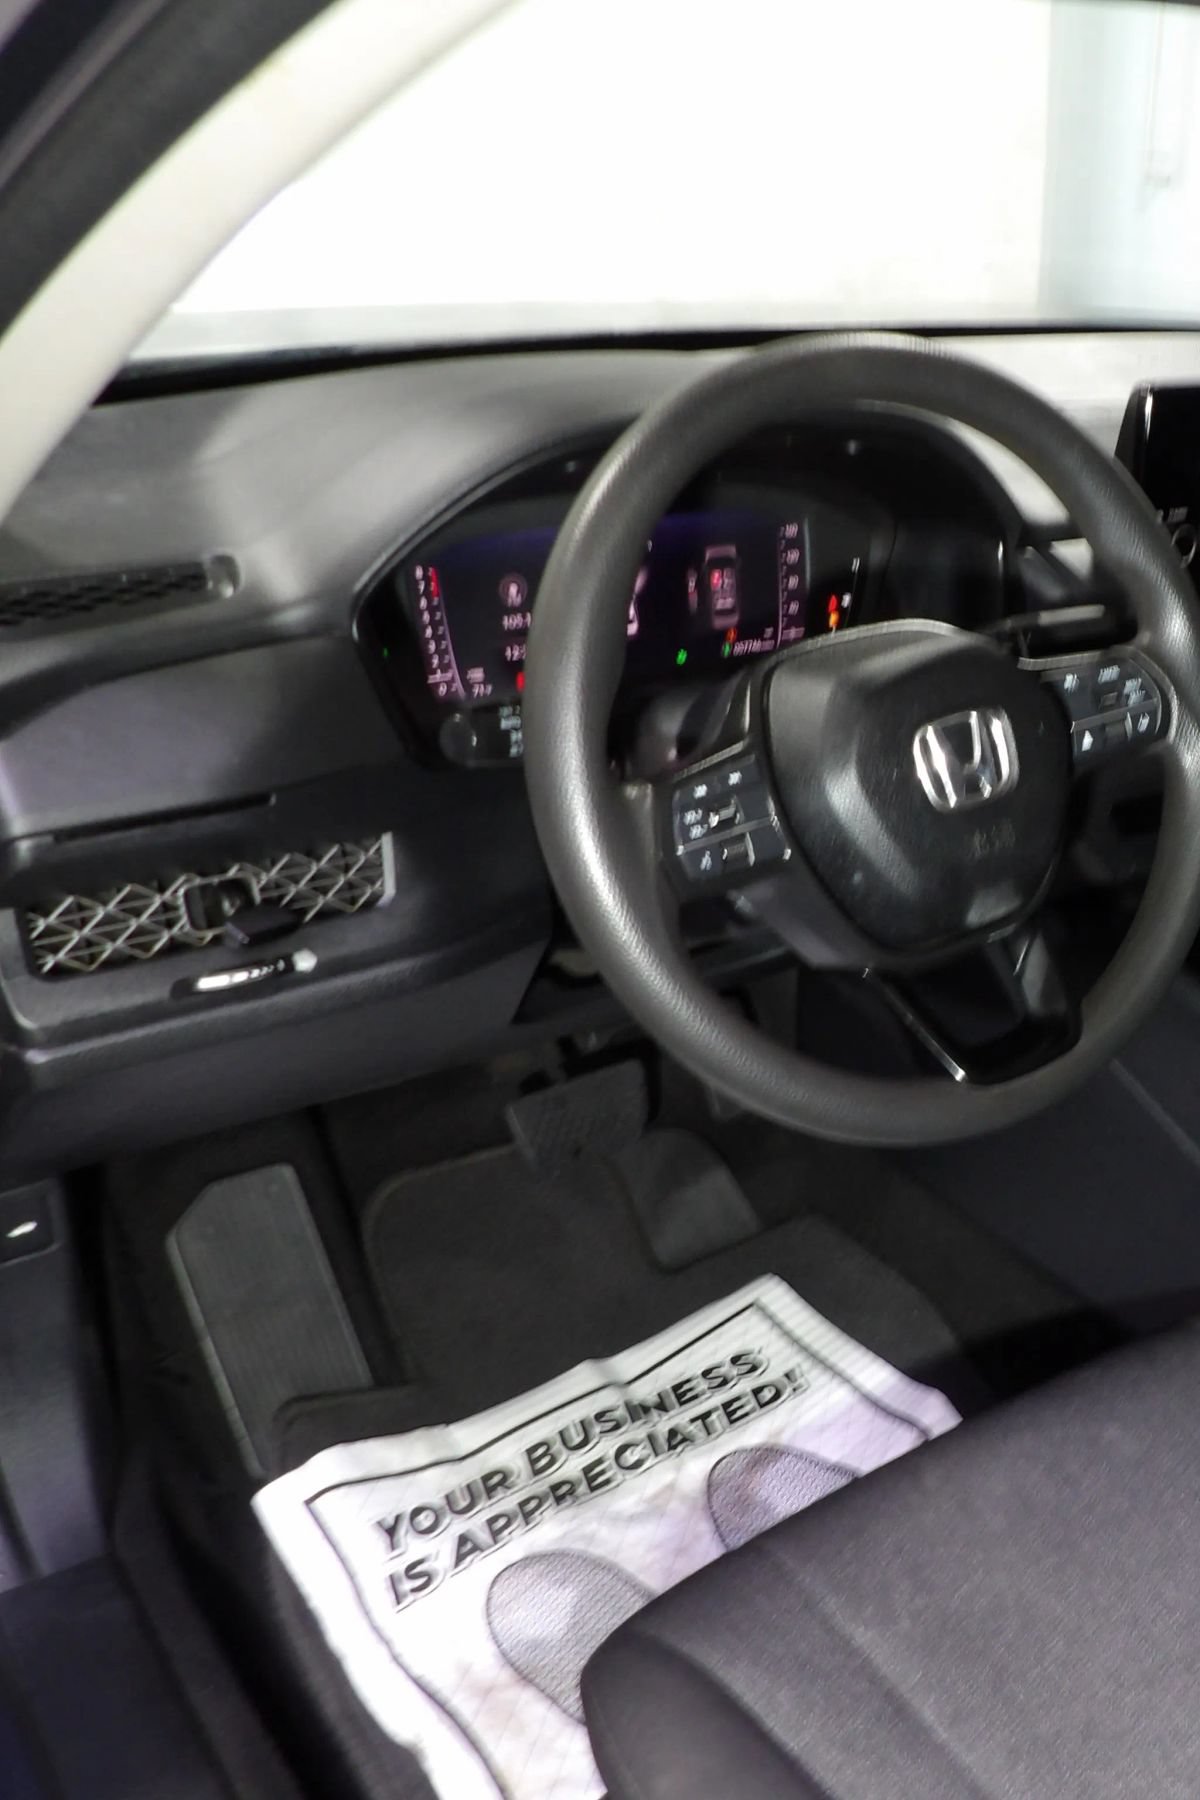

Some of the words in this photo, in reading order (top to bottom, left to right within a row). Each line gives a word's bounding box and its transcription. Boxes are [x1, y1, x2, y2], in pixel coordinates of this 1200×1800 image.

[376, 1464, 515, 1556] YOUR
[524, 1348, 769, 1477] BUSINESS
[388, 1556, 438, 1608] IS
[451, 1368, 809, 1573] APPRECIATED!
